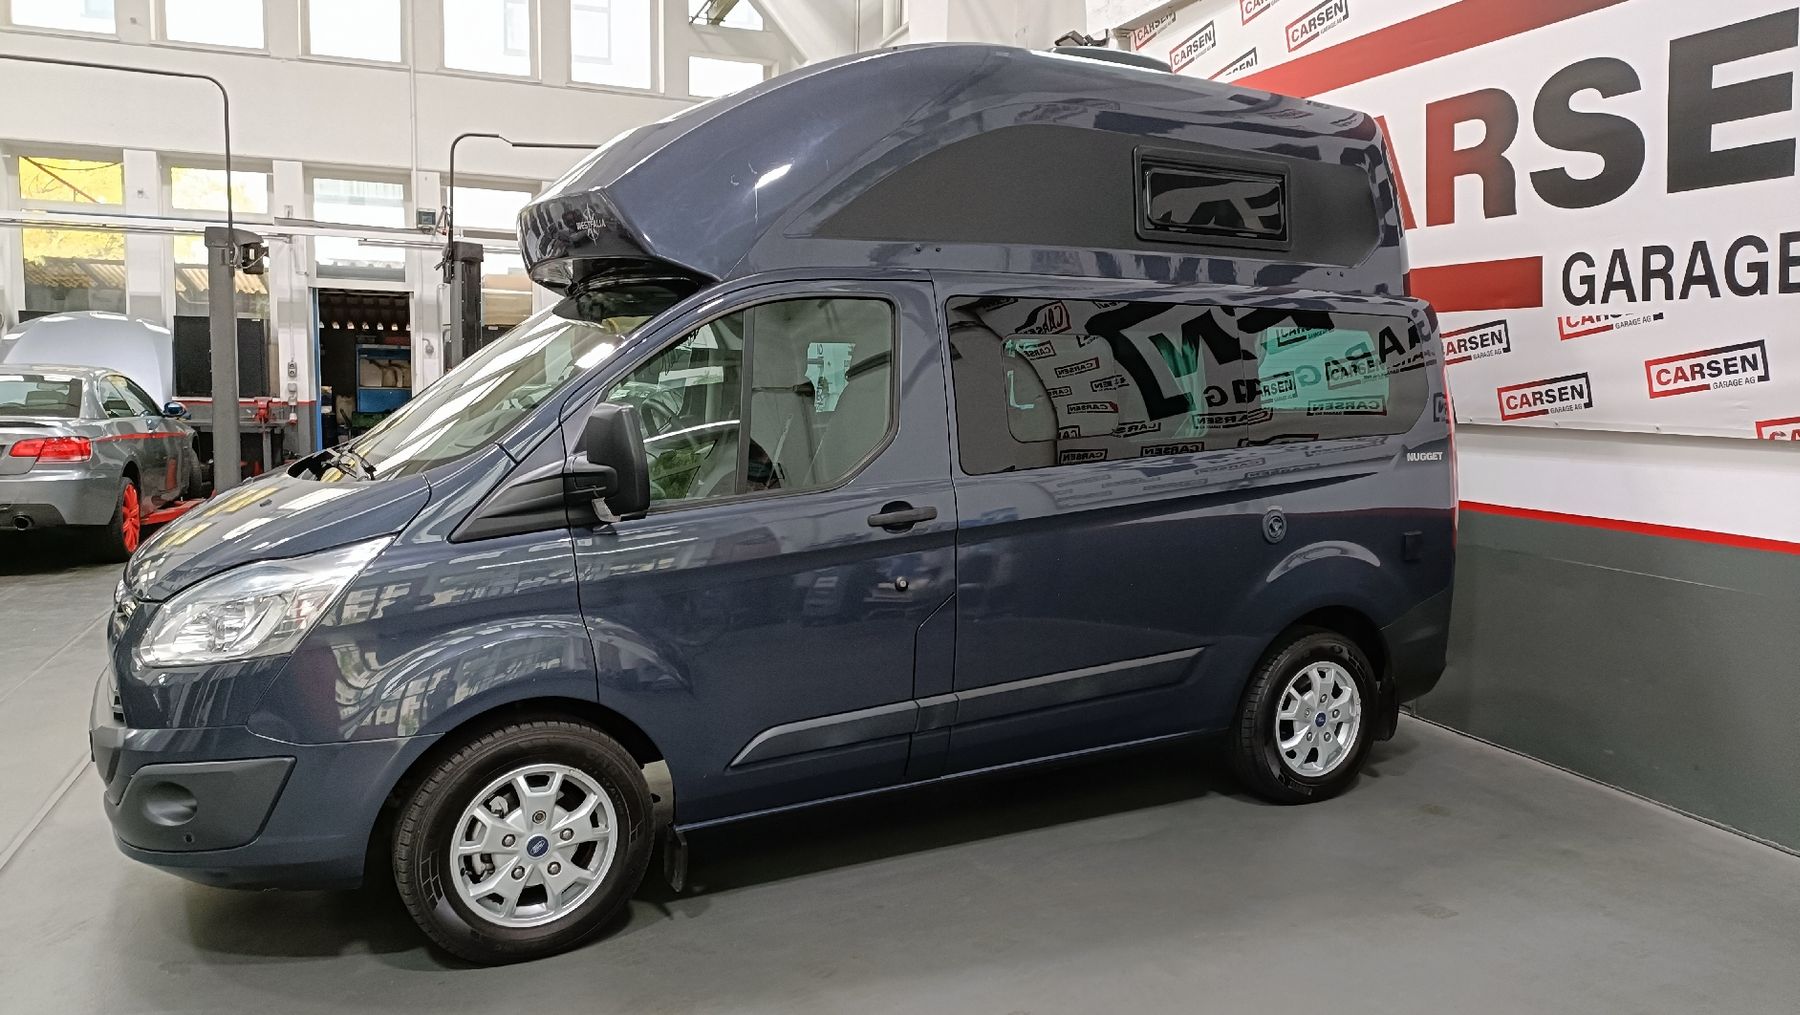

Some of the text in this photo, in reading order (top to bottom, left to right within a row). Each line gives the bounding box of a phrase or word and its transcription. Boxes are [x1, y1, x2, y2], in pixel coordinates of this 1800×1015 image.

[1291, 1, 1344, 42] CARSEN
[1173, 30, 1212, 66] CARSEN
[1380, 7, 1799, 230] RSE
[1615, 317, 1641, 330] GARAGE
[1642, 315, 1652, 324] AG
[1443, 329, 1503, 356] ARSEN
[1655, 353, 1759, 385] CARSEN
[1712, 376, 1755, 390] GARAGE AG
[1505, 384, 1585, 410] CARSEN
[1550, 403, 1583, 414] GARAGE AG
[1407, 451, 1443, 462] NUGGET
